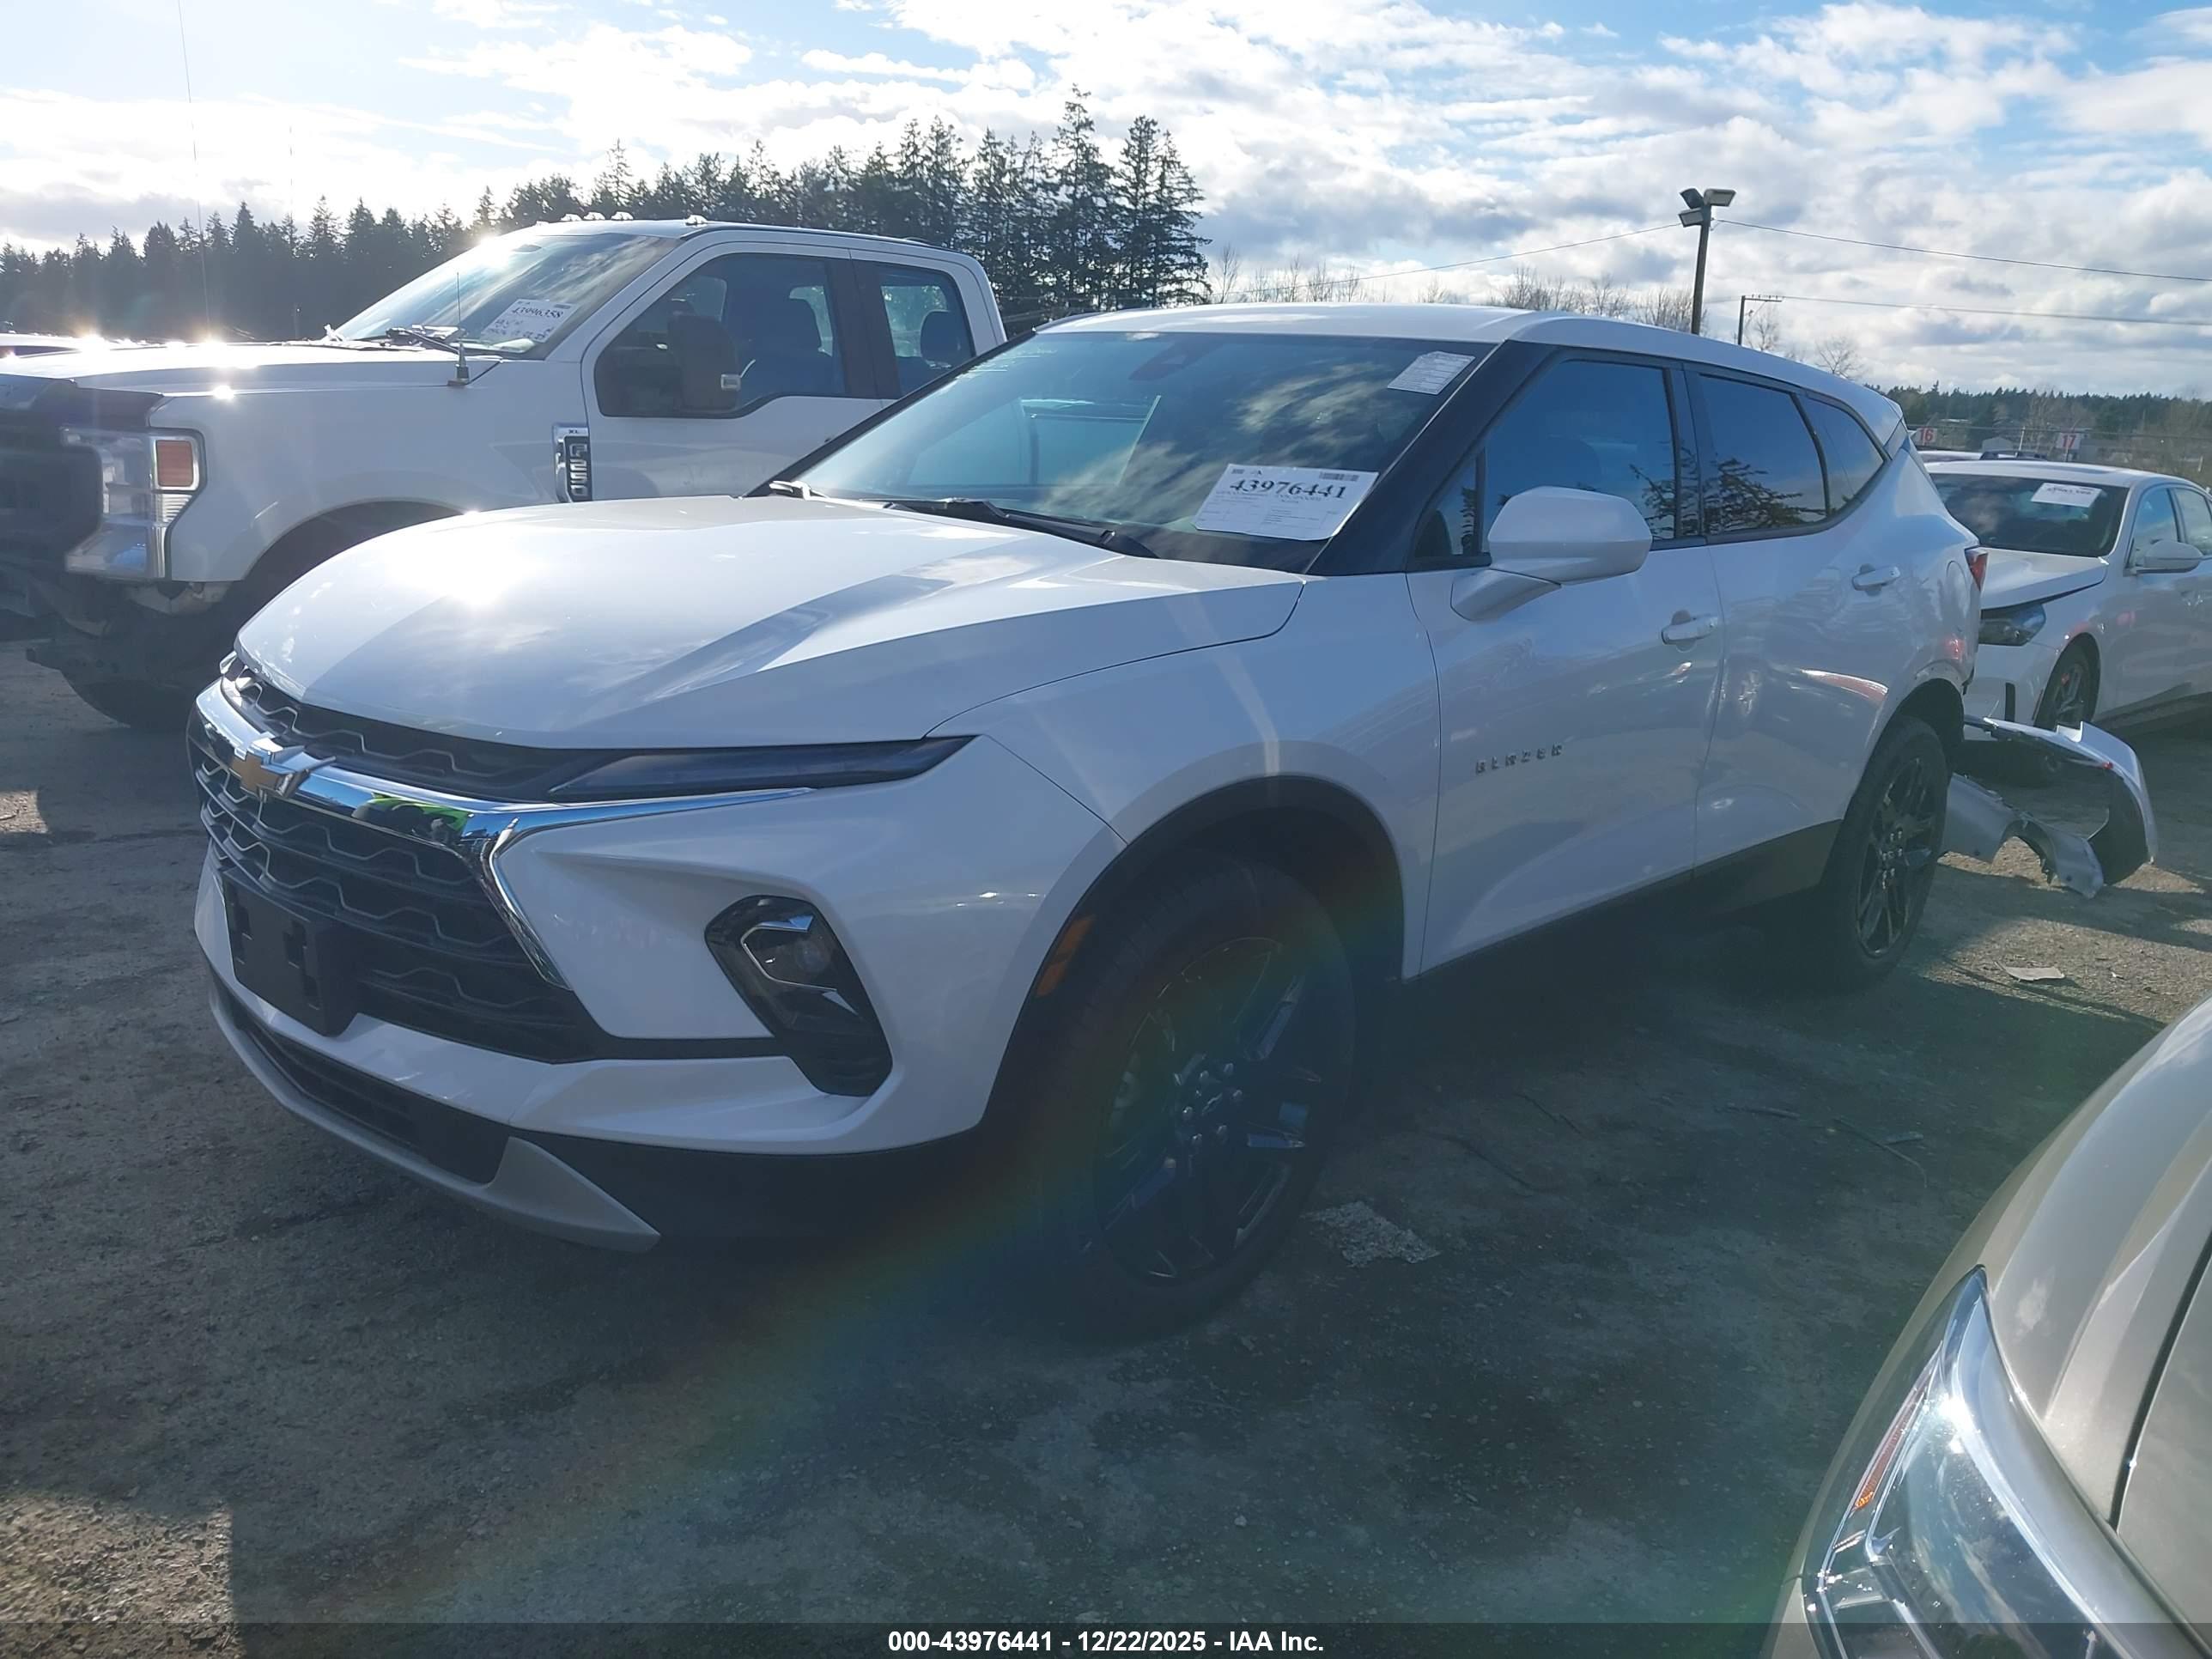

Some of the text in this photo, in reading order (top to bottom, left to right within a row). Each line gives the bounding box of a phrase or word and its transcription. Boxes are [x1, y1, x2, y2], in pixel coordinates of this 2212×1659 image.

[1919, 428, 1934, 441] 16
[2063, 434, 2076, 447] 17
[1230, 478, 1346, 499] 43976441
[1475, 742, 1563, 775] BLAZER
